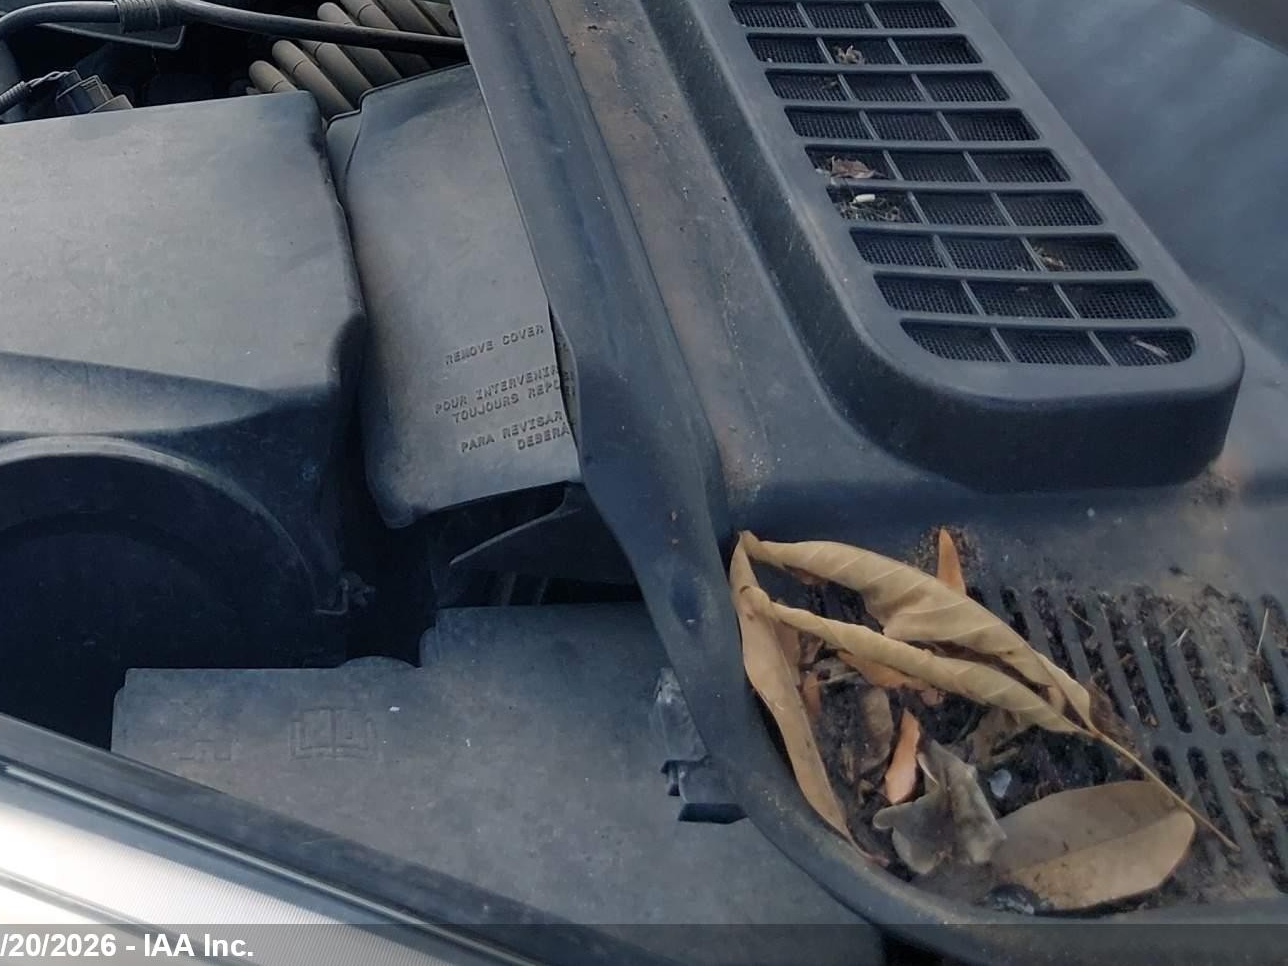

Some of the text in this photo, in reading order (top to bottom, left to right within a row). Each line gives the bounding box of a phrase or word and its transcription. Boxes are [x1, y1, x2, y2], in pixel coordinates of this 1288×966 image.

[445, 324, 544, 365] REMOVE COVER
[434, 395, 467, 414] POUR
[452, 393, 519, 423] TOUJOURS
[461, 410, 563, 453] PARA REVISAR
